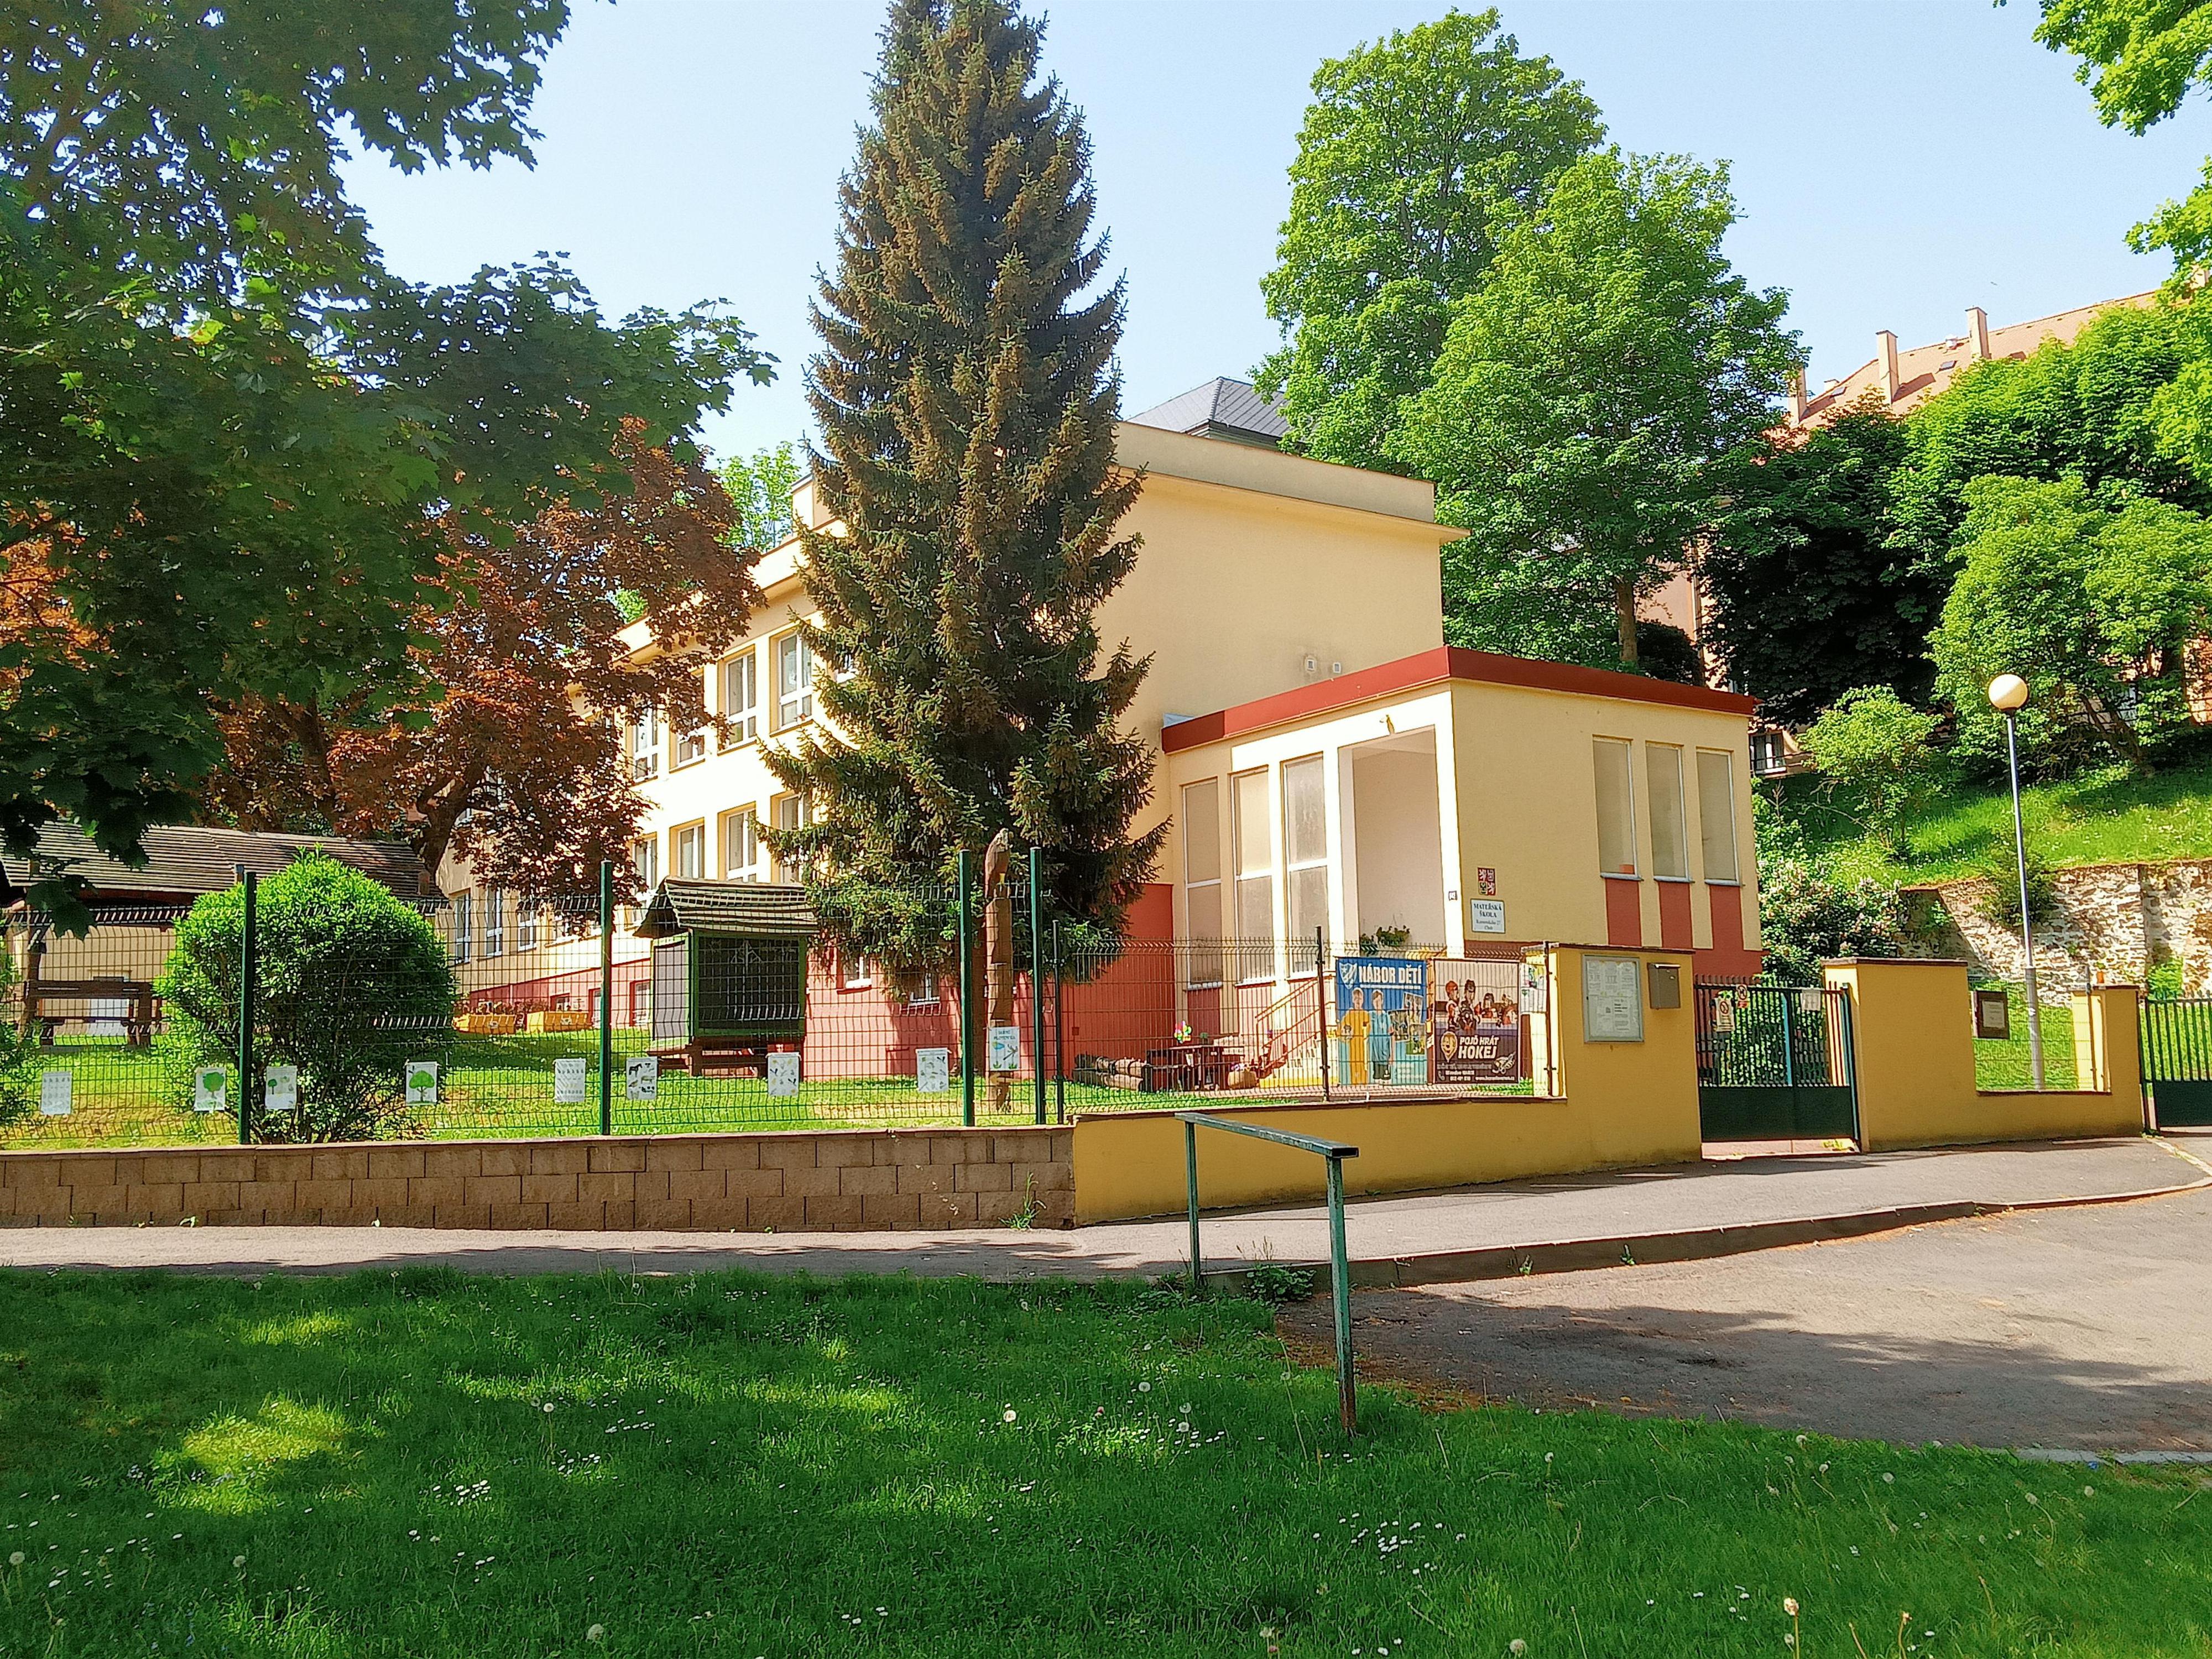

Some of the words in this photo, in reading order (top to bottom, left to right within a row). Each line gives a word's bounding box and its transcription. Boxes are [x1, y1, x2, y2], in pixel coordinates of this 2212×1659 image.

[1359, 963, 1396, 983] NÁBOR
[1399, 964, 1422, 984] DĚTÍ
[1460, 1035, 1479, 1045] POJĎ
[1479, 1035, 1499, 1045] HRÁT
[1458, 1046, 1497, 1059] HOKEJ
